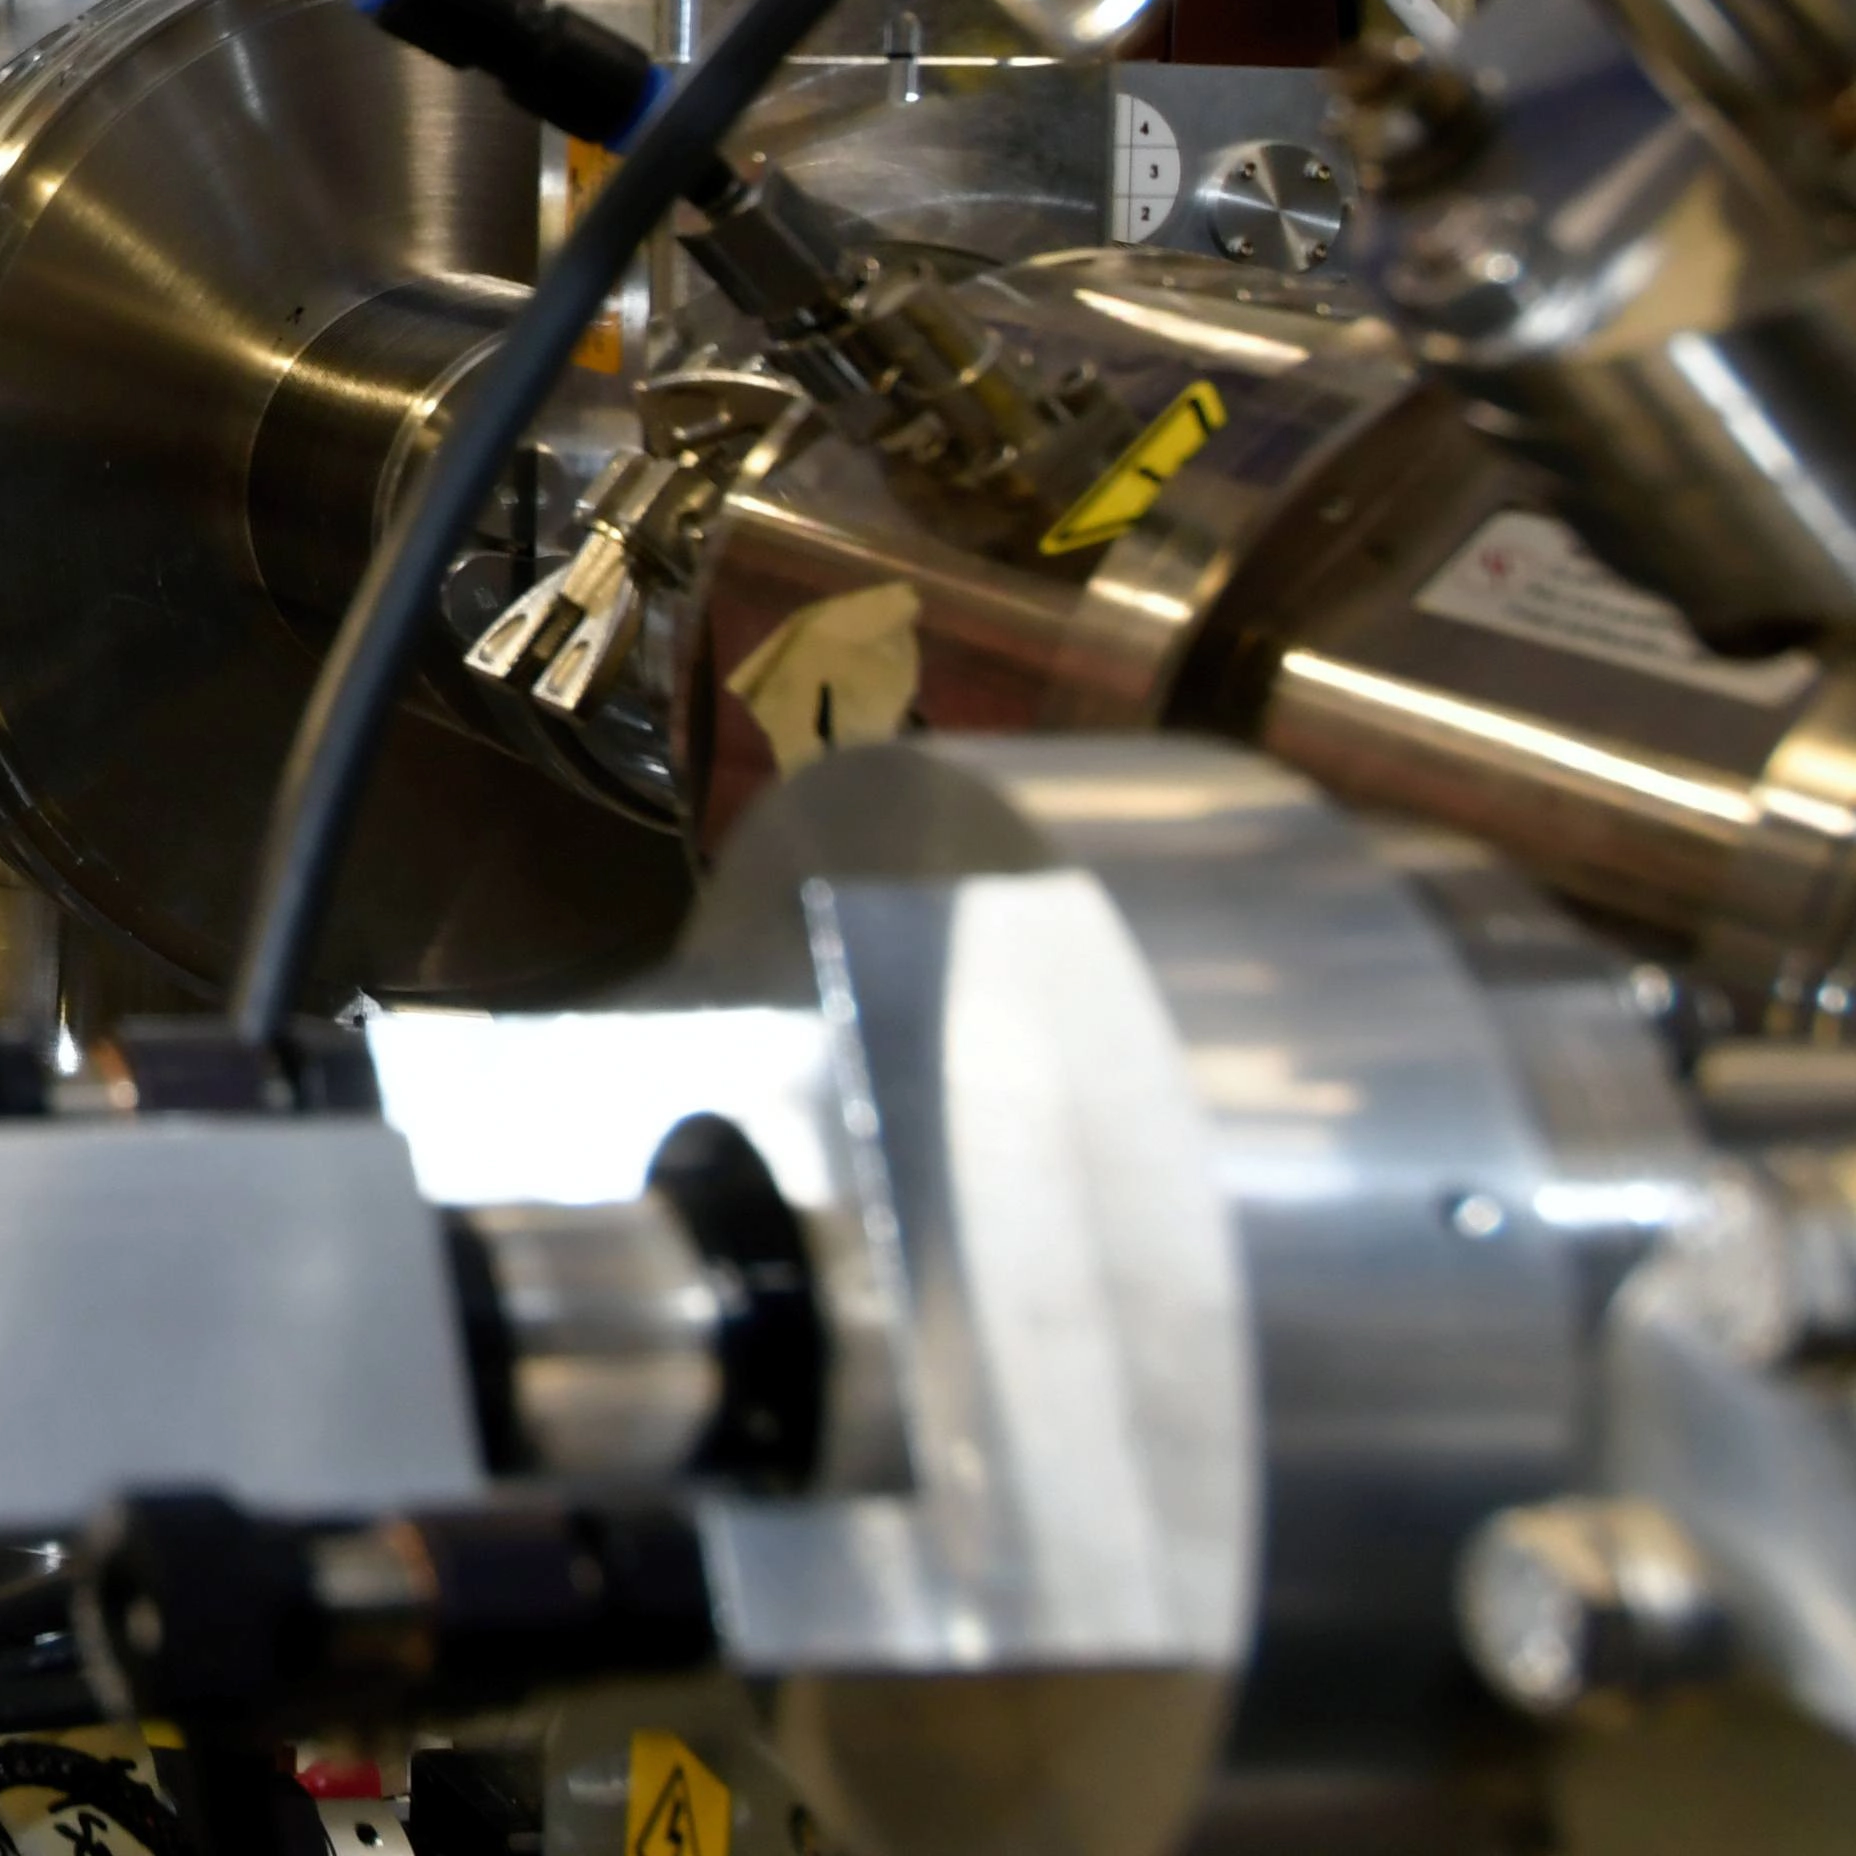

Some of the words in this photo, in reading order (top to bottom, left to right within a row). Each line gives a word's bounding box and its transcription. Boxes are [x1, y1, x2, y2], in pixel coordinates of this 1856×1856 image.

[1139, 121, 1150, 136] 4
[1149, 164, 1159, 180] 3
[1141, 206, 1151, 222] 2
